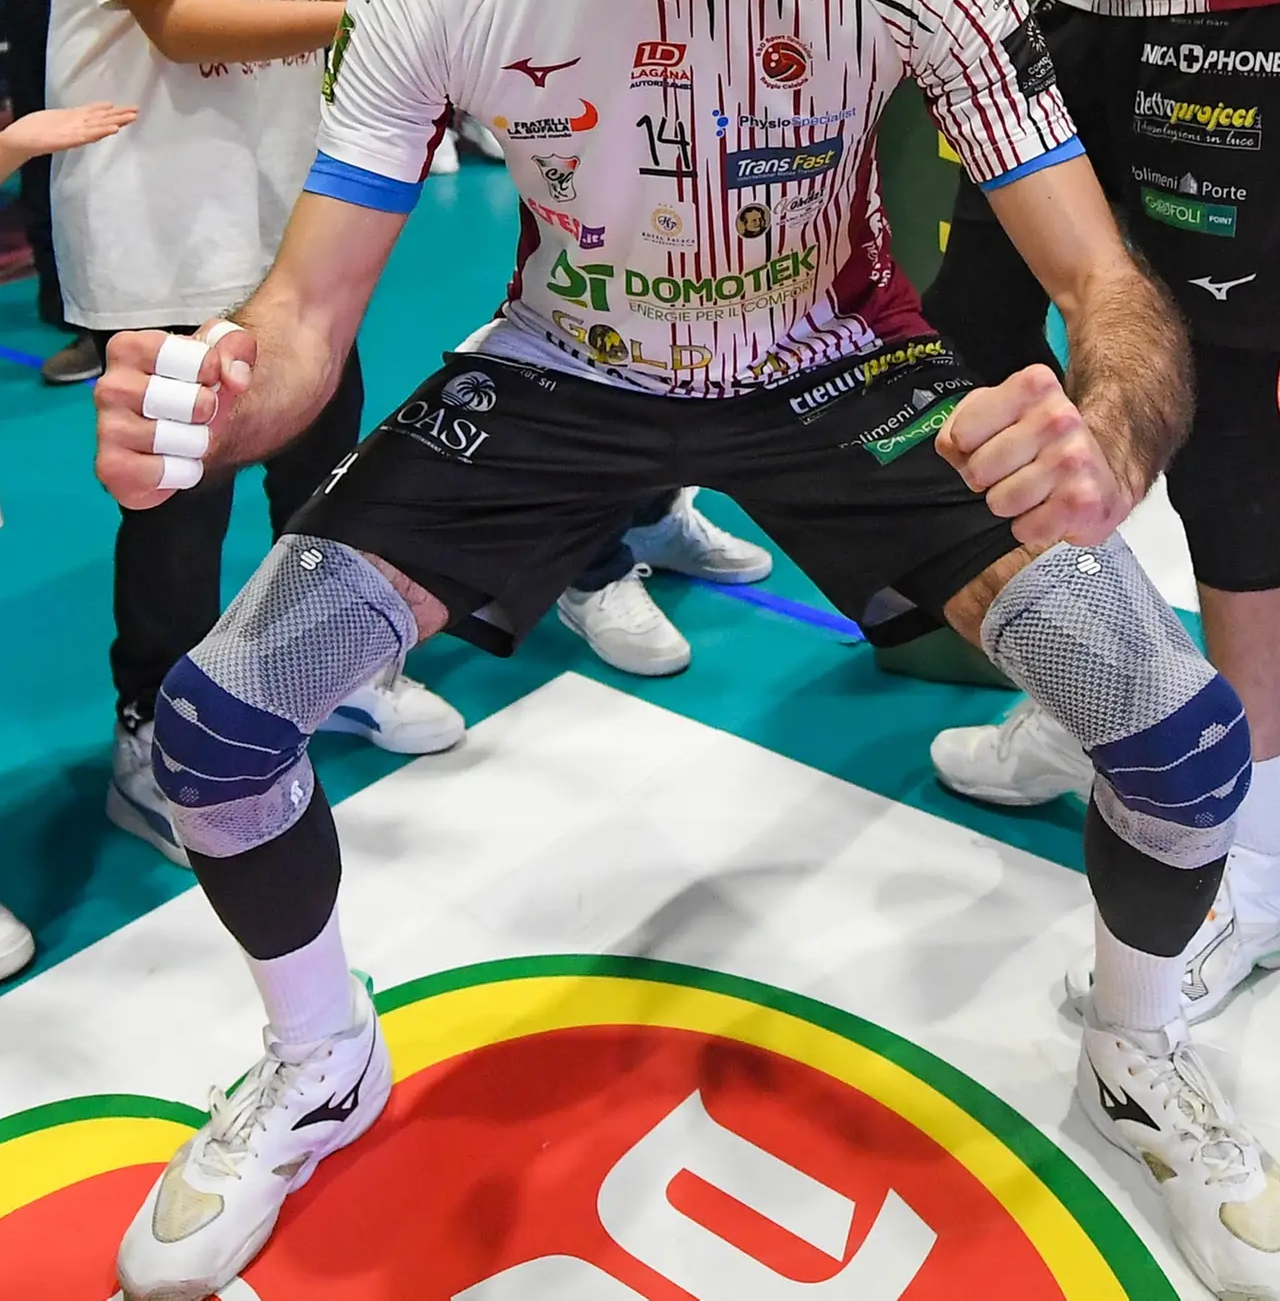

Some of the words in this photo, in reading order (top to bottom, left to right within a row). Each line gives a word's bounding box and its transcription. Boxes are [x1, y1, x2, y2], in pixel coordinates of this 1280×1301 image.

[513, 117, 569, 129] FRATELLI
[739, 107, 857, 130] PhysioSpecialist
[525, 125, 570, 136] BUFALA
[636, 114, 690, 170] 14
[737, 157, 790, 177] Trans
[792, 149, 836, 171] Fast
[1202, 181, 1248, 201] Porte
[1208, 215, 1233, 226] POINT
[625, 242, 819, 304] DOMOTEK
[628, 301, 691, 323] ENERGIE
[695, 308, 725, 323] PER
[728, 306, 740, 319] IL
[743, 277, 816, 313] COMFORT
[538, 376, 558, 393] srl
[396, 400, 490, 458] OASI
